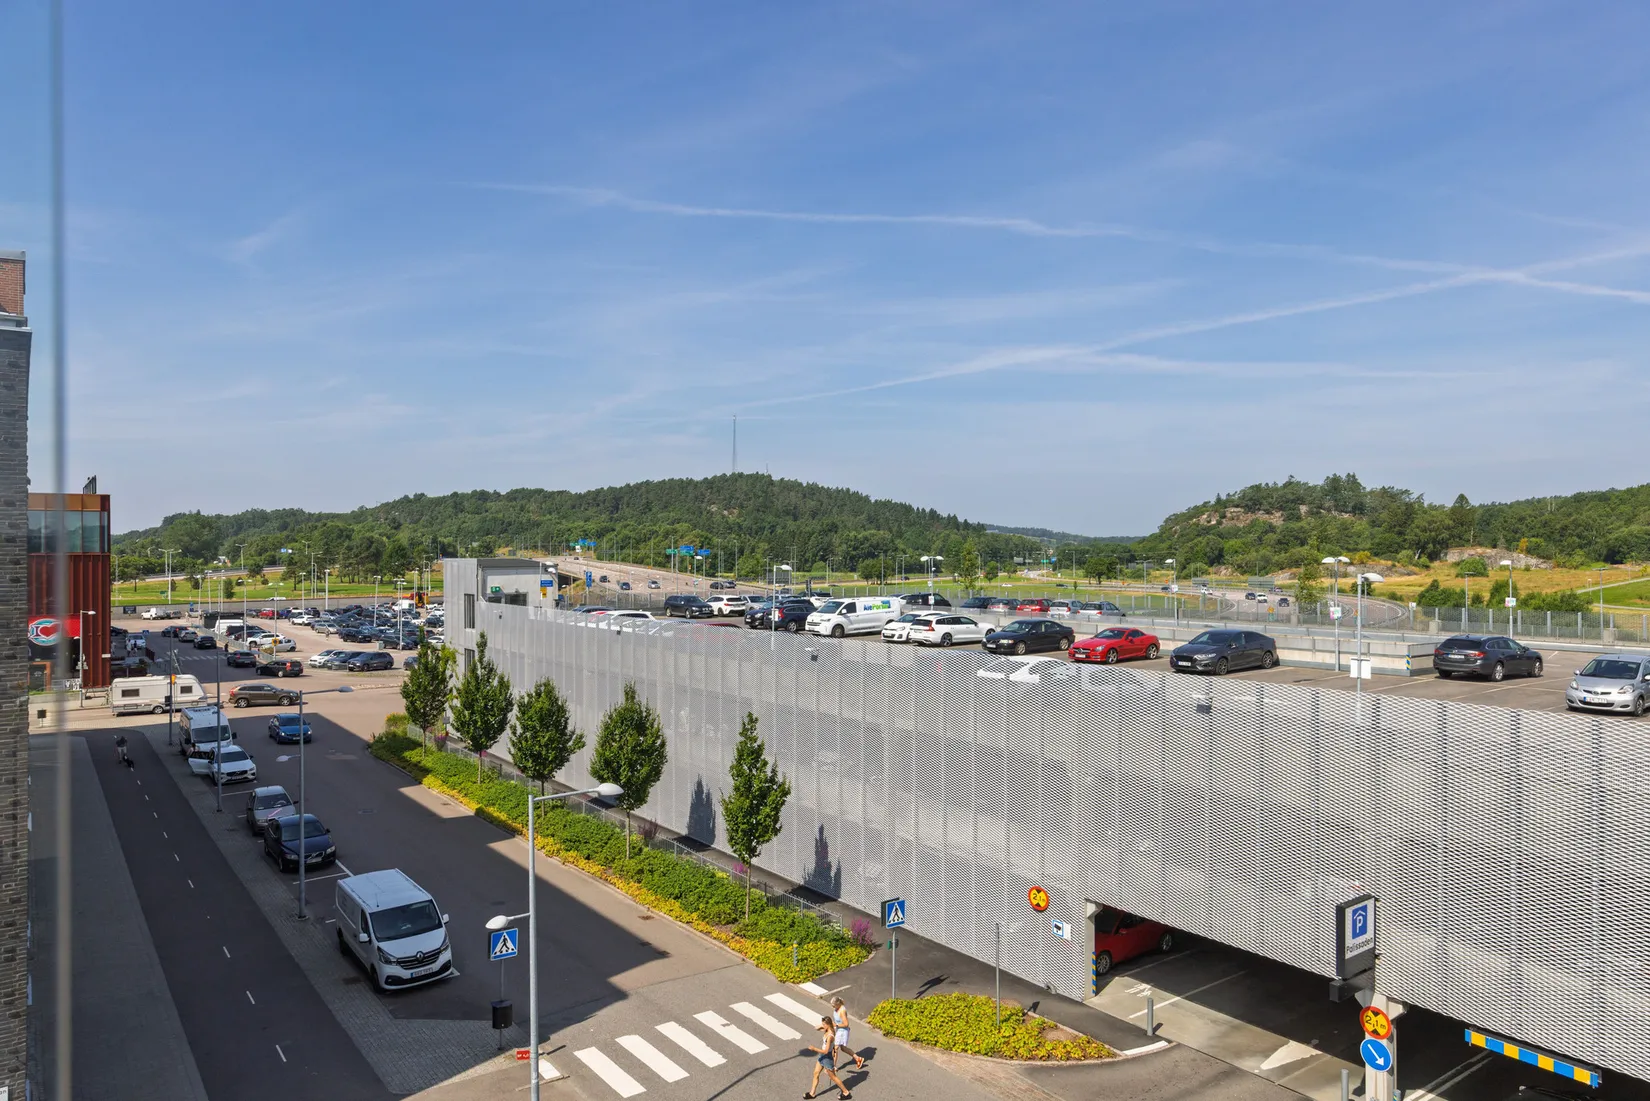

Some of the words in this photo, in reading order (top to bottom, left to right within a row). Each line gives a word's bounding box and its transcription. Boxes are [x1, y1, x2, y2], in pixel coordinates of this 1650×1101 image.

[1356, 915, 1363, 934] P
[1346, 937, 1374, 955] Palissaden
[1365, 1014, 1379, 1028] 2,1
